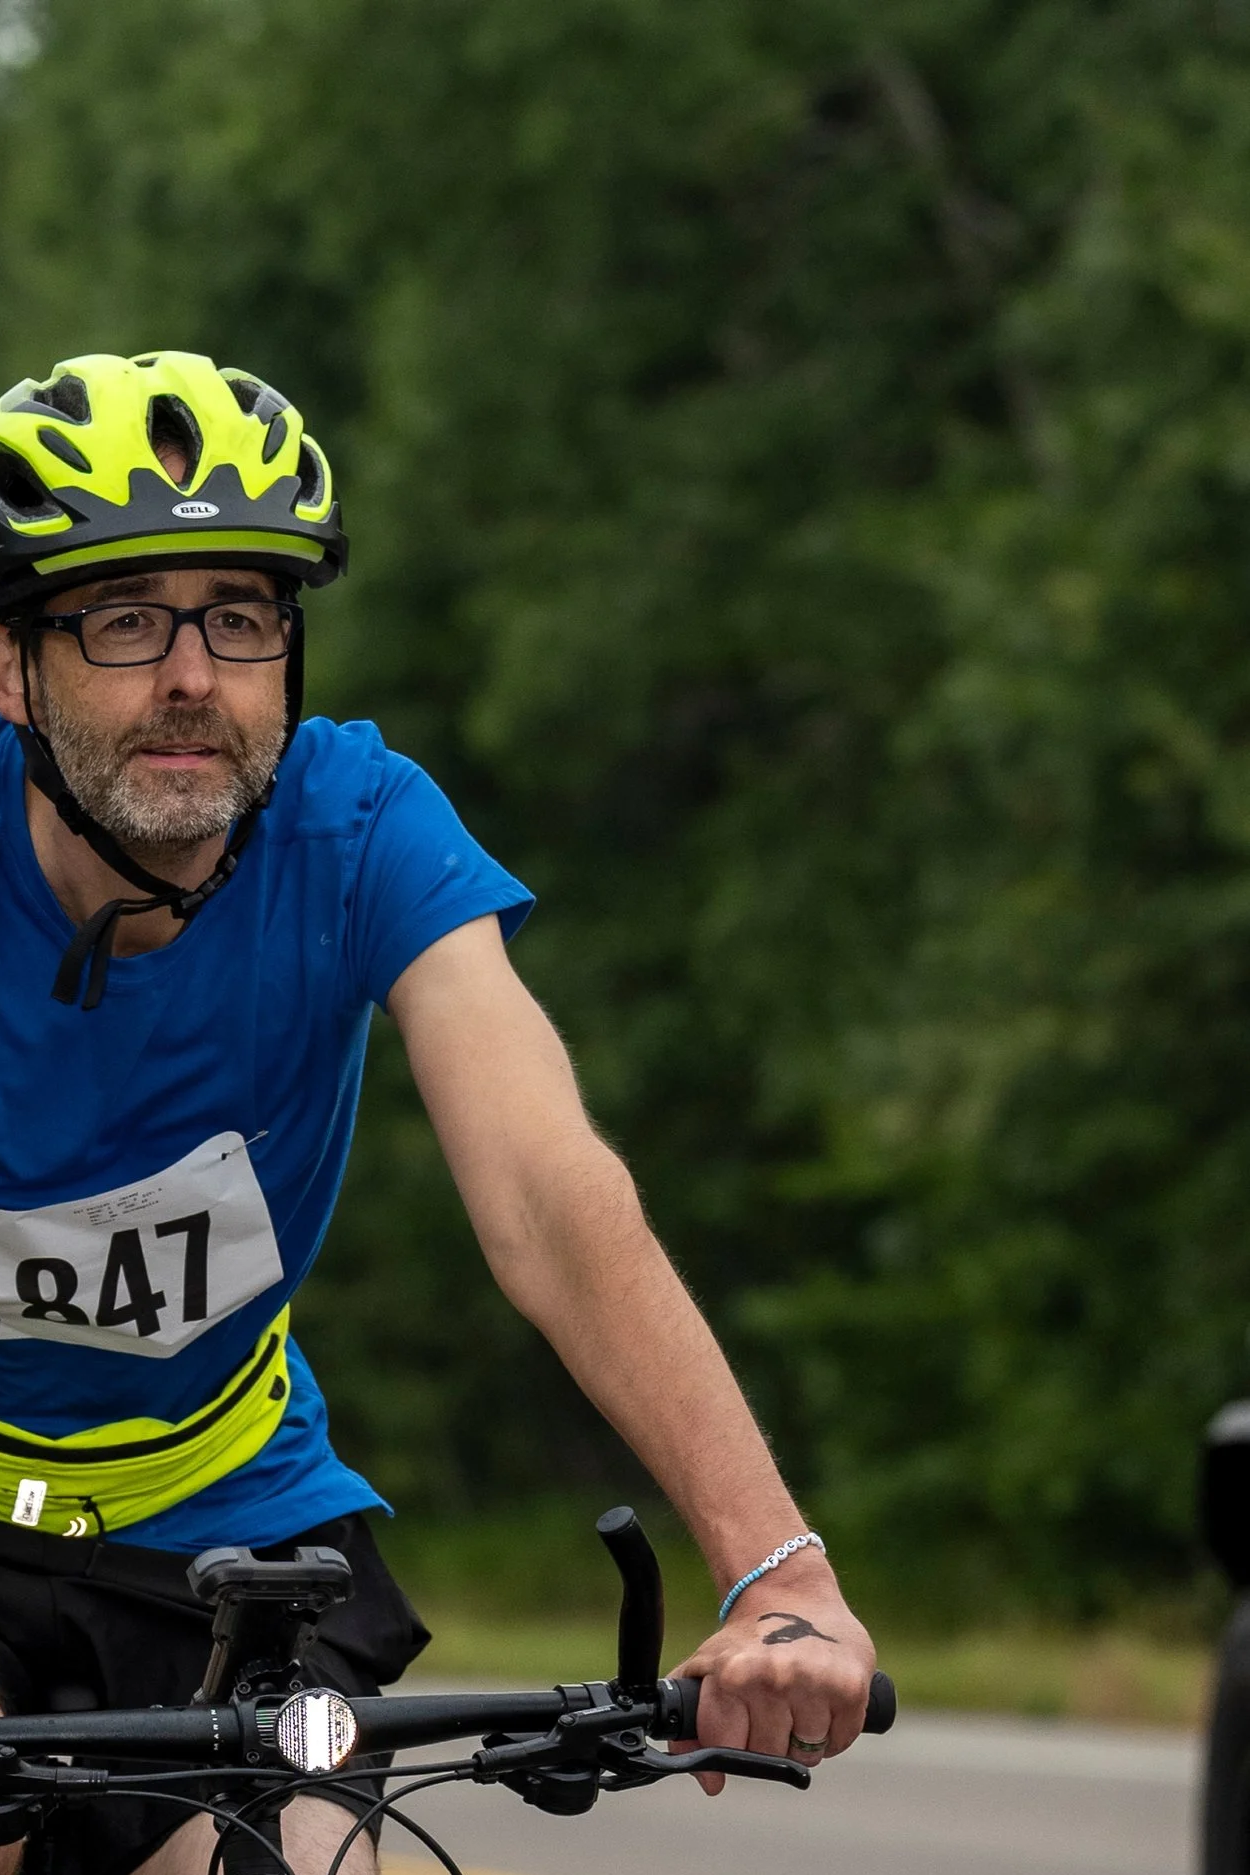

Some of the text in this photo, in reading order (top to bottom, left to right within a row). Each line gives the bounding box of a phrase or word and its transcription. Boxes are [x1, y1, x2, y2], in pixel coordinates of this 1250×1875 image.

[180, 506, 212, 514] BELL
[15, 1210, 211, 1338] 847
[210, 1709, 220, 1751] MARIN
